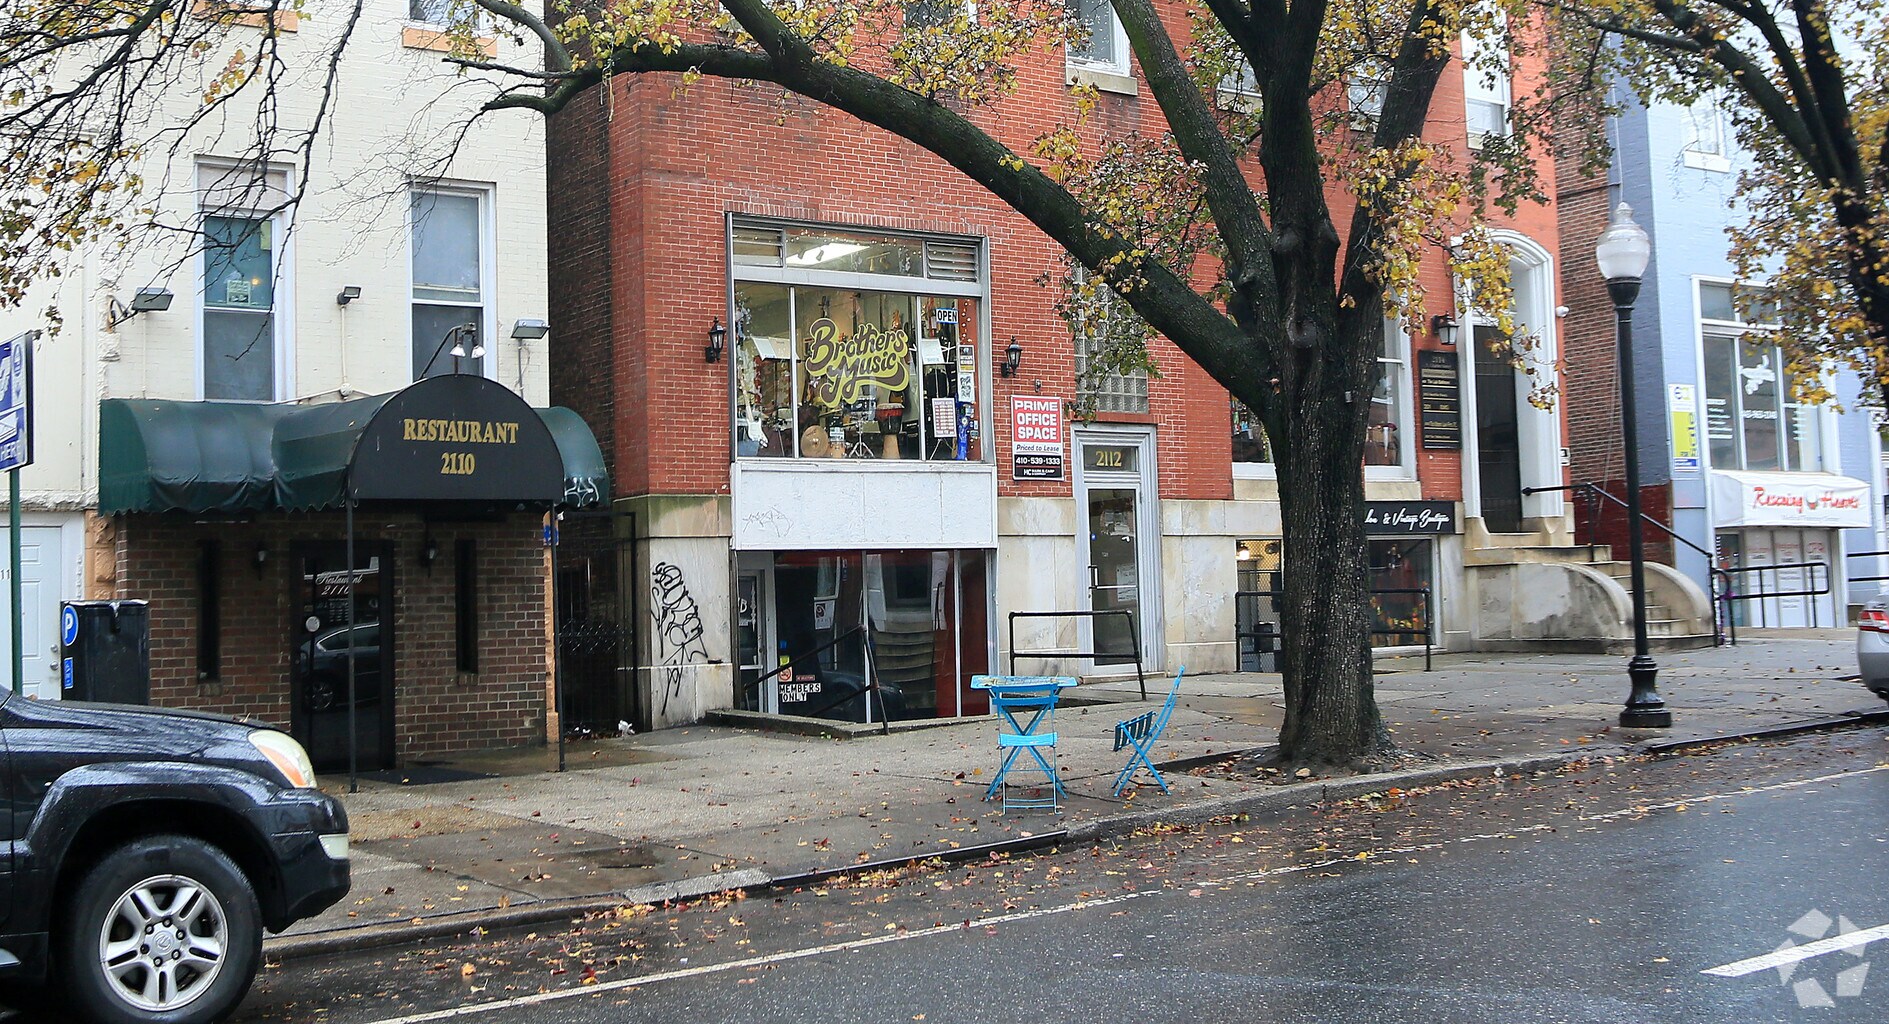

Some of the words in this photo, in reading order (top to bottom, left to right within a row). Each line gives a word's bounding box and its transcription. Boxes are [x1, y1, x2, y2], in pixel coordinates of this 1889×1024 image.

[937, 310, 958, 322] OPEN
[806, 318, 908, 373] Brothers
[820, 351, 908, 406] Music
[1014, 399, 1059, 412] PRIME
[1016, 412, 1058, 426] OFFICE
[402, 418, 520, 444] RESTAURANT
[1017, 426, 1058, 440] SPACE
[1043, 445, 1060, 453] Lease
[440, 451, 477, 476] 2110
[1095, 450, 1122, 467] 2112
[315, 573, 363, 586] Restaurnt
[65, 613, 73, 640] P
[780, 683, 821, 693] MEMBERS
[783, 693, 806, 702] ONLY
